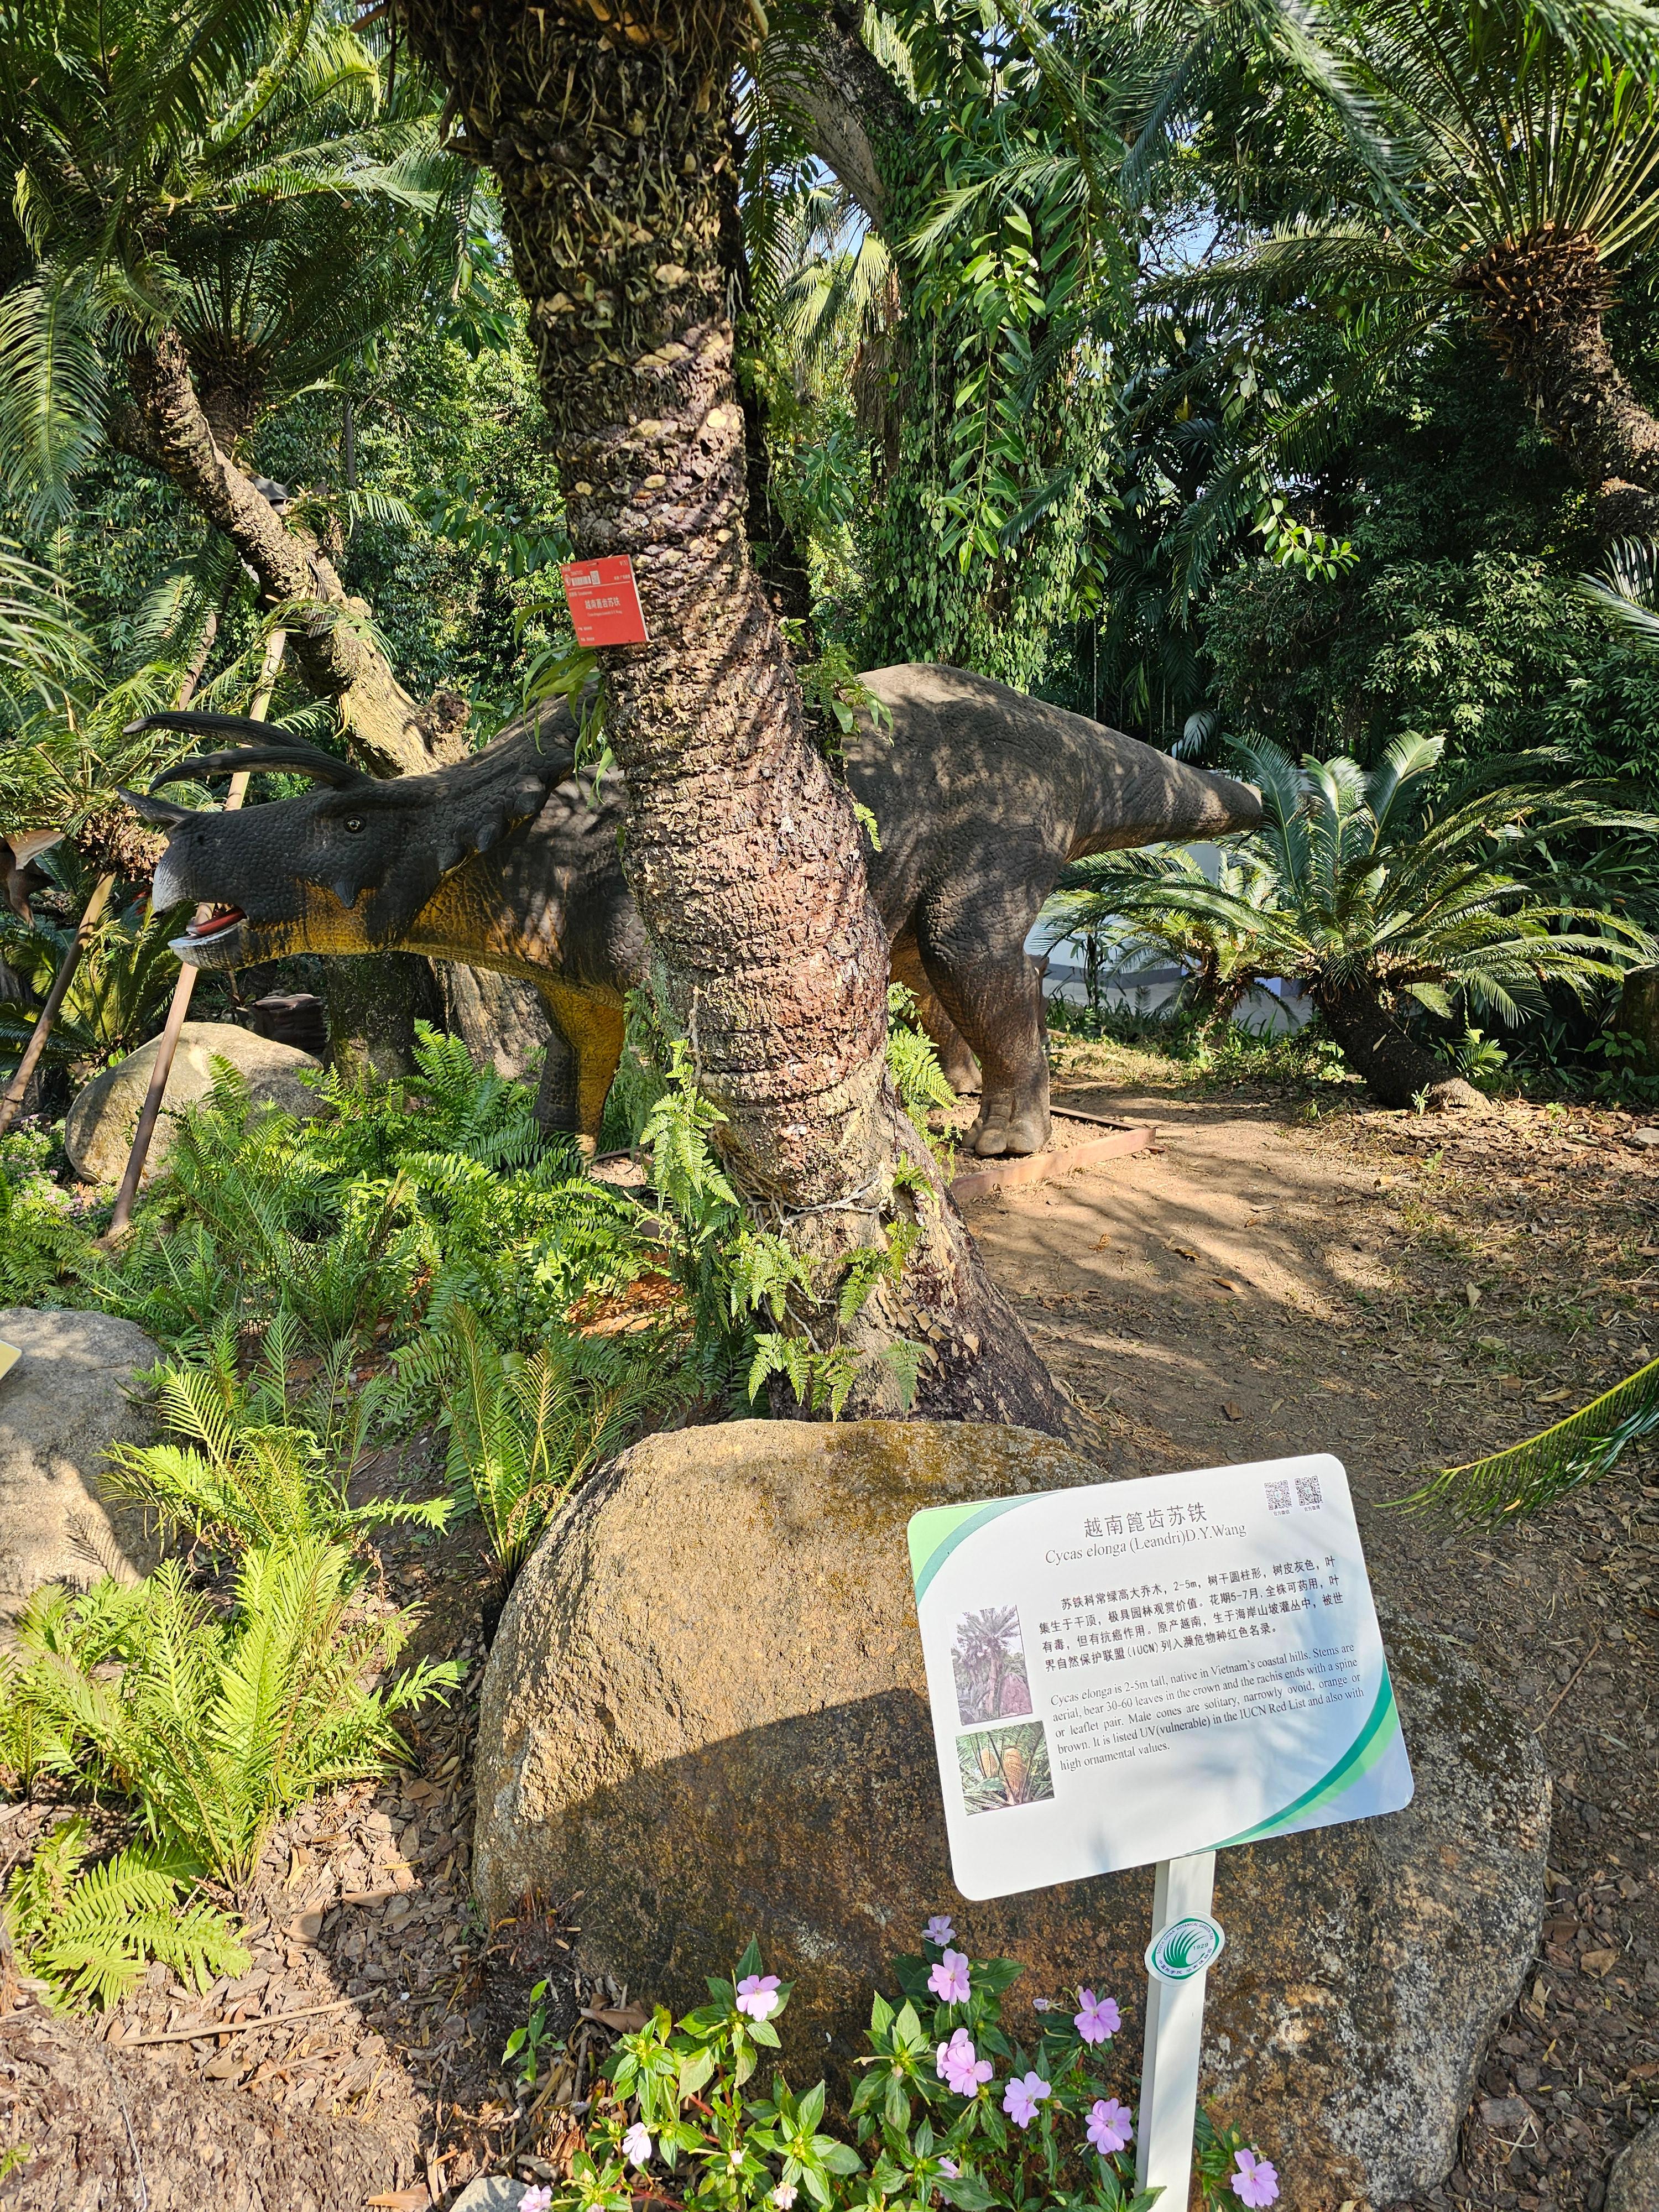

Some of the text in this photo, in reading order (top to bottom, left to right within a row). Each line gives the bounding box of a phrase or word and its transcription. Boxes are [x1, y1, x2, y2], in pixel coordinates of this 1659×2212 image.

[1084, 1501, 1207, 1538] 越南篦齿苏铁
[1045, 1549, 1083, 1566] Cycas
[1086, 1543, 1126, 1557] elonga
[1285, 1666, 1306, 1678] ends
[1306, 1662, 1326, 1674] with
[1335, 1658, 1358, 1672] spine
[1051, 1645, 1354, 1707] Cycas elonga is 2-5m tall, native in Vietnam’s coastal hills. Stems are
[1240, 1669, 1282, 1684] rachis
[1240, 1676, 1255, 1687] the
[1192, 1684, 1221, 1695] crown
[1223, 1677, 1239, 1691] and
[1135, 1694, 1164, 1706] leaves
[1165, 1690, 1175, 1700] in
[1177, 1688, 1191, 1699] the
[1055, 1729, 1065, 1738] or
[1070, 1721, 1099, 1735] leaflet
[1103, 1716, 1124, 1731] pair.
[1128, 1710, 1151, 1724] Male
[1156, 1707, 1182, 1719] cones
[1186, 1704, 1200, 1713] are
[1204, 1697, 1240, 1710] solitary,
[1243, 1687, 1282, 1703] narrowly
[1287, 1680, 1315, 1694] ovoid,
[1318, 1677, 1348, 1688] orange
[1083, 1705, 1104, 1715] bear
[1105, 1697, 1133, 1712] 30-60
[1053, 1707, 1082, 1722] aerial,
[1057, 1687, 1364, 1754] brown. It is listed UV(vulnerable) in the IUCN Red List and also with
[1060, 1743, 1170, 1772] high ornamental values.
[1164, 1930, 1175, 1940] CHINA
